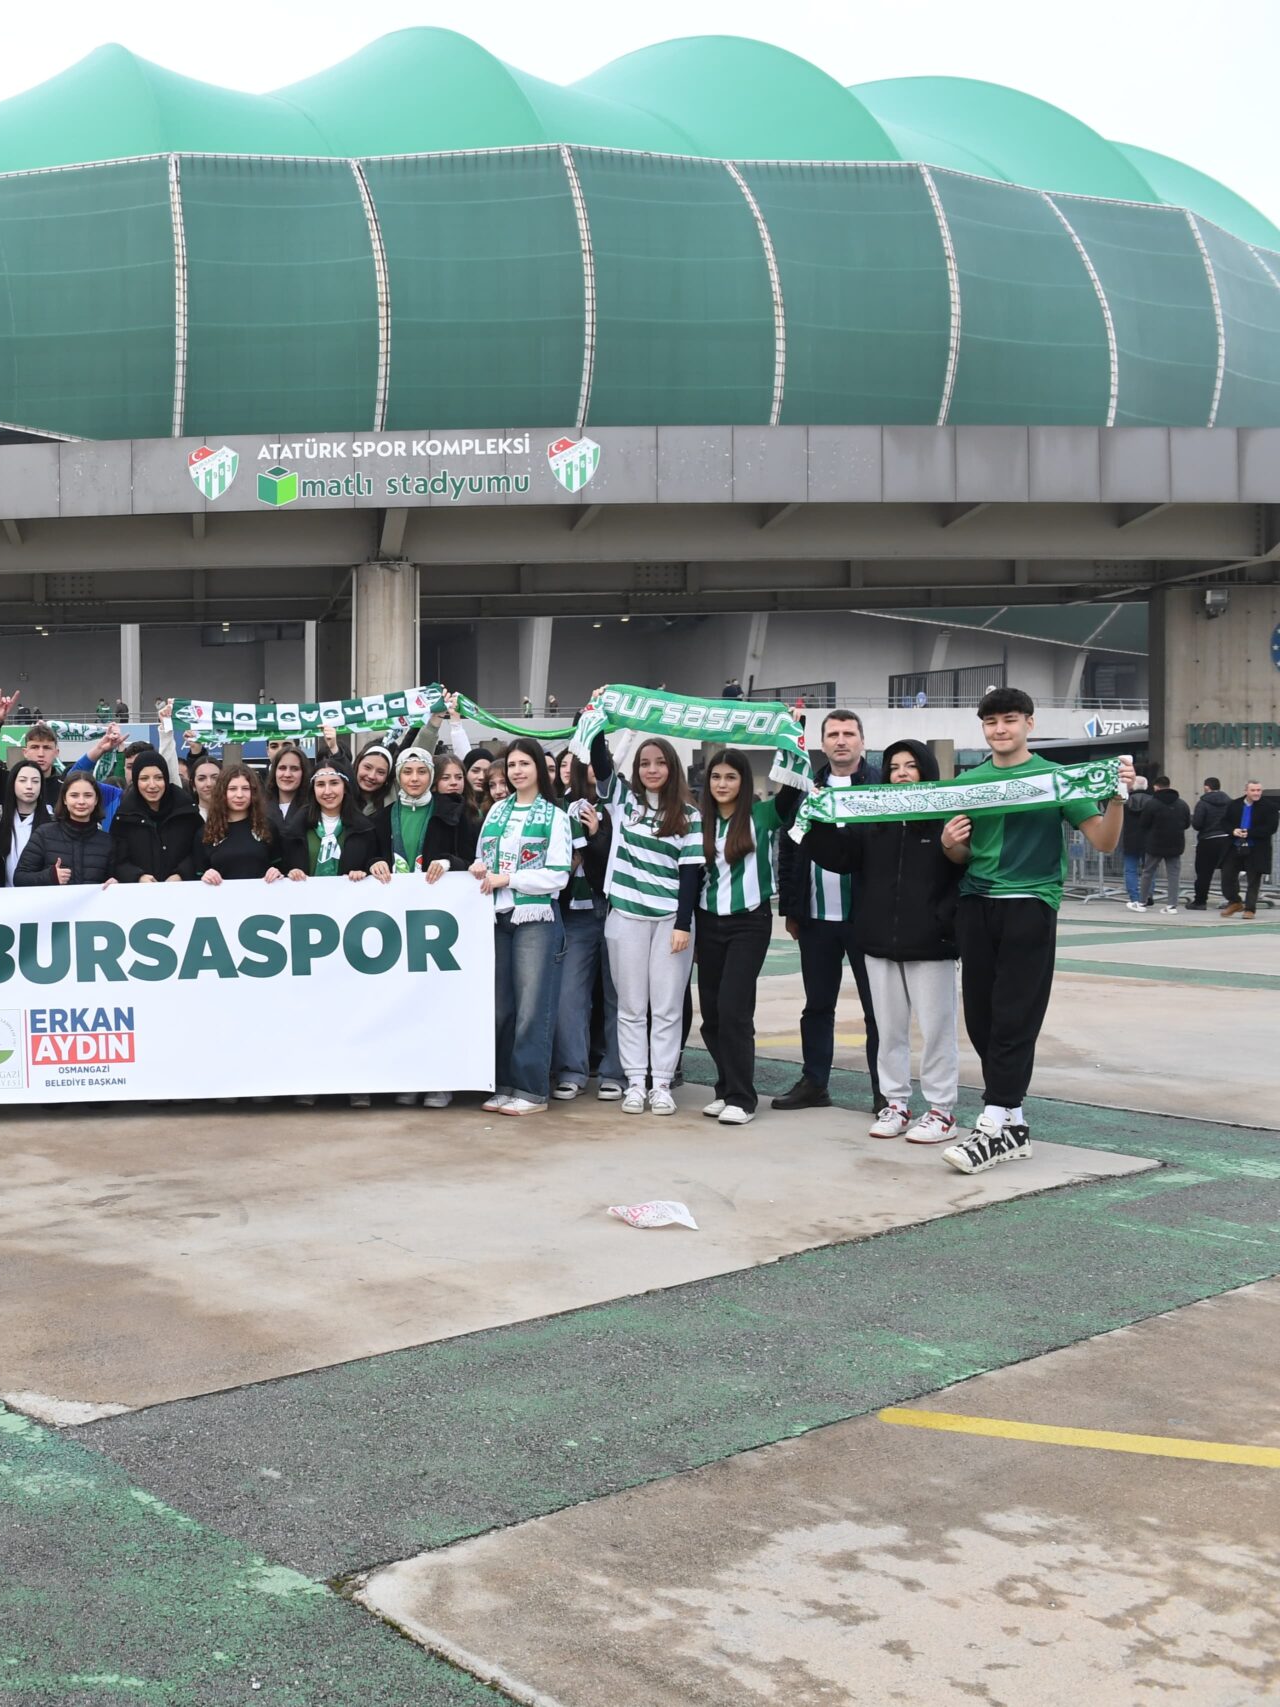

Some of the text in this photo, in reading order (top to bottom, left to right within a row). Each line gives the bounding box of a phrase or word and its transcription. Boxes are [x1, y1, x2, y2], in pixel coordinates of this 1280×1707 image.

[257, 432, 530, 460] ATATÜRK SPOR KOMPLEKSİ
[386, 470, 530, 500] stadyumu
[30, 1007, 135, 1033] ERKAN
[34, 1033, 131, 1062] AYDIN
[45, 1077, 127, 1088] BELEDİYE BAŞKANI
[58, 1065, 111, 1074] OSMANGAZİ
